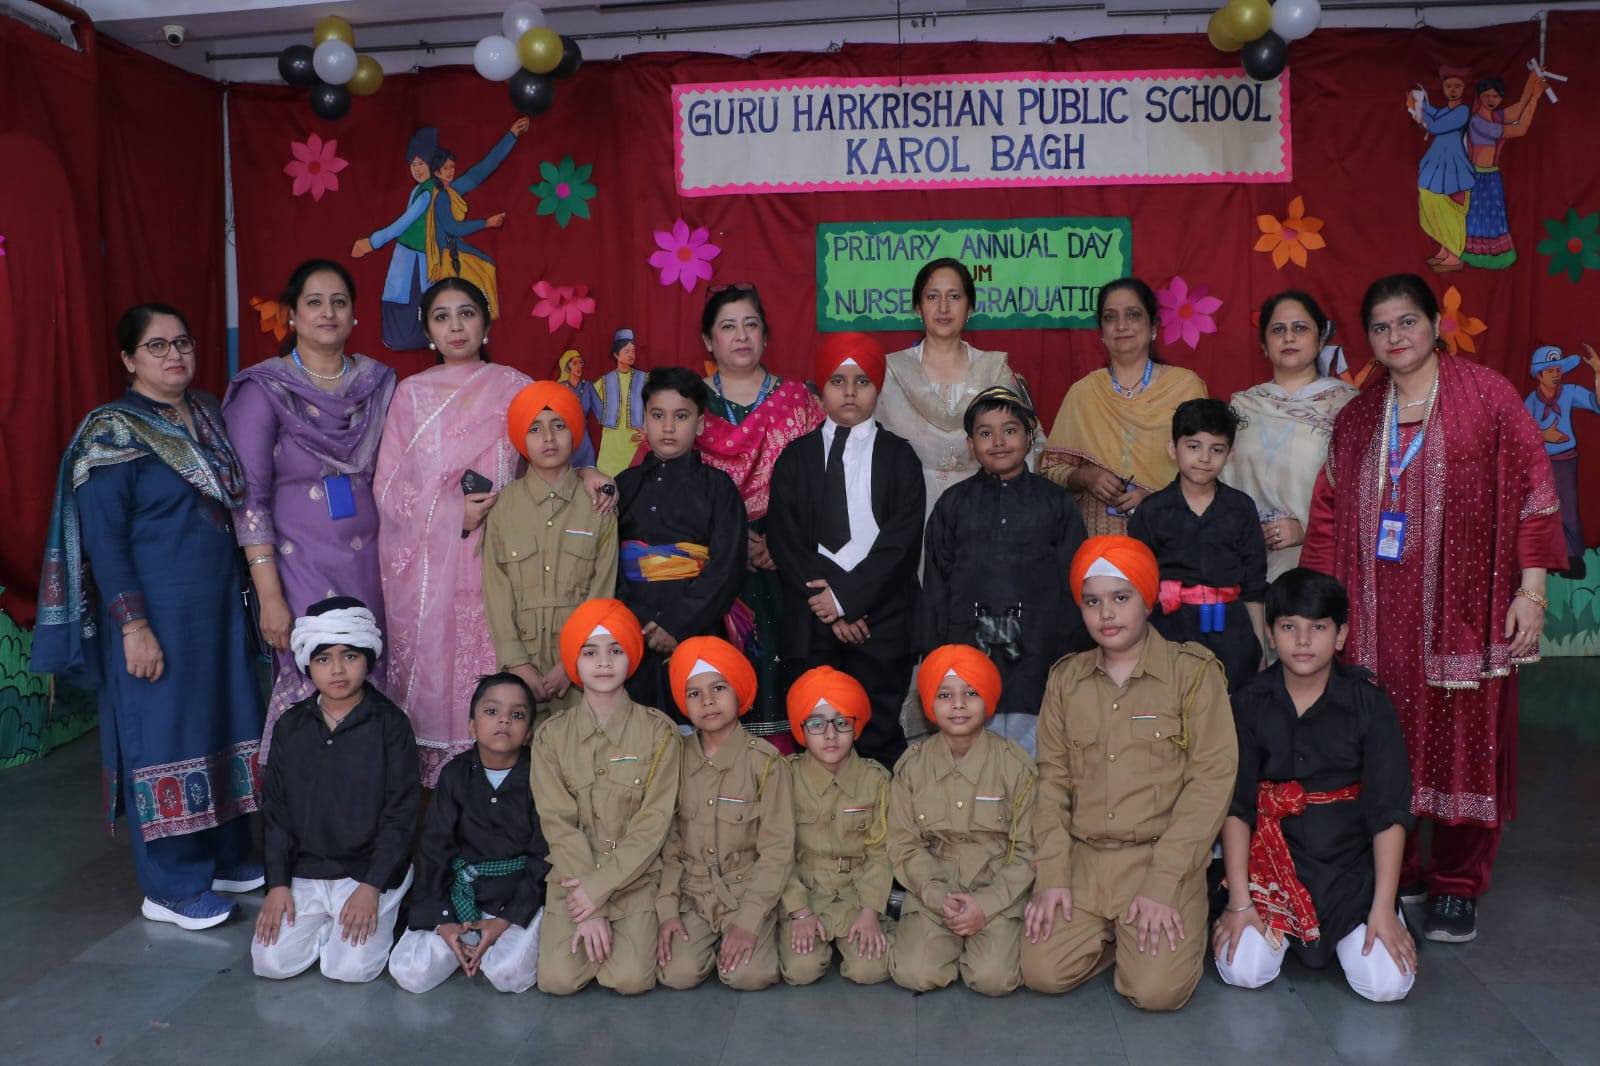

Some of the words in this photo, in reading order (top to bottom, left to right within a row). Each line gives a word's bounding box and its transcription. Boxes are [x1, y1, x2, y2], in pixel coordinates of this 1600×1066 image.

[687, 96, 780, 137] GURU
[792, 89, 1004, 132] HARKRISHAN
[1018, 86, 1129, 126] PUBLIC
[1145, 82, 1272, 124] SCHOOL
[846, 135, 970, 175] KAROL
[990, 133, 1086, 171] BAGH
[833, 233, 941, 262] PRIMARY
[959, 231, 1058, 260] ANNUAL
[1067, 231, 1114, 259] DAY
